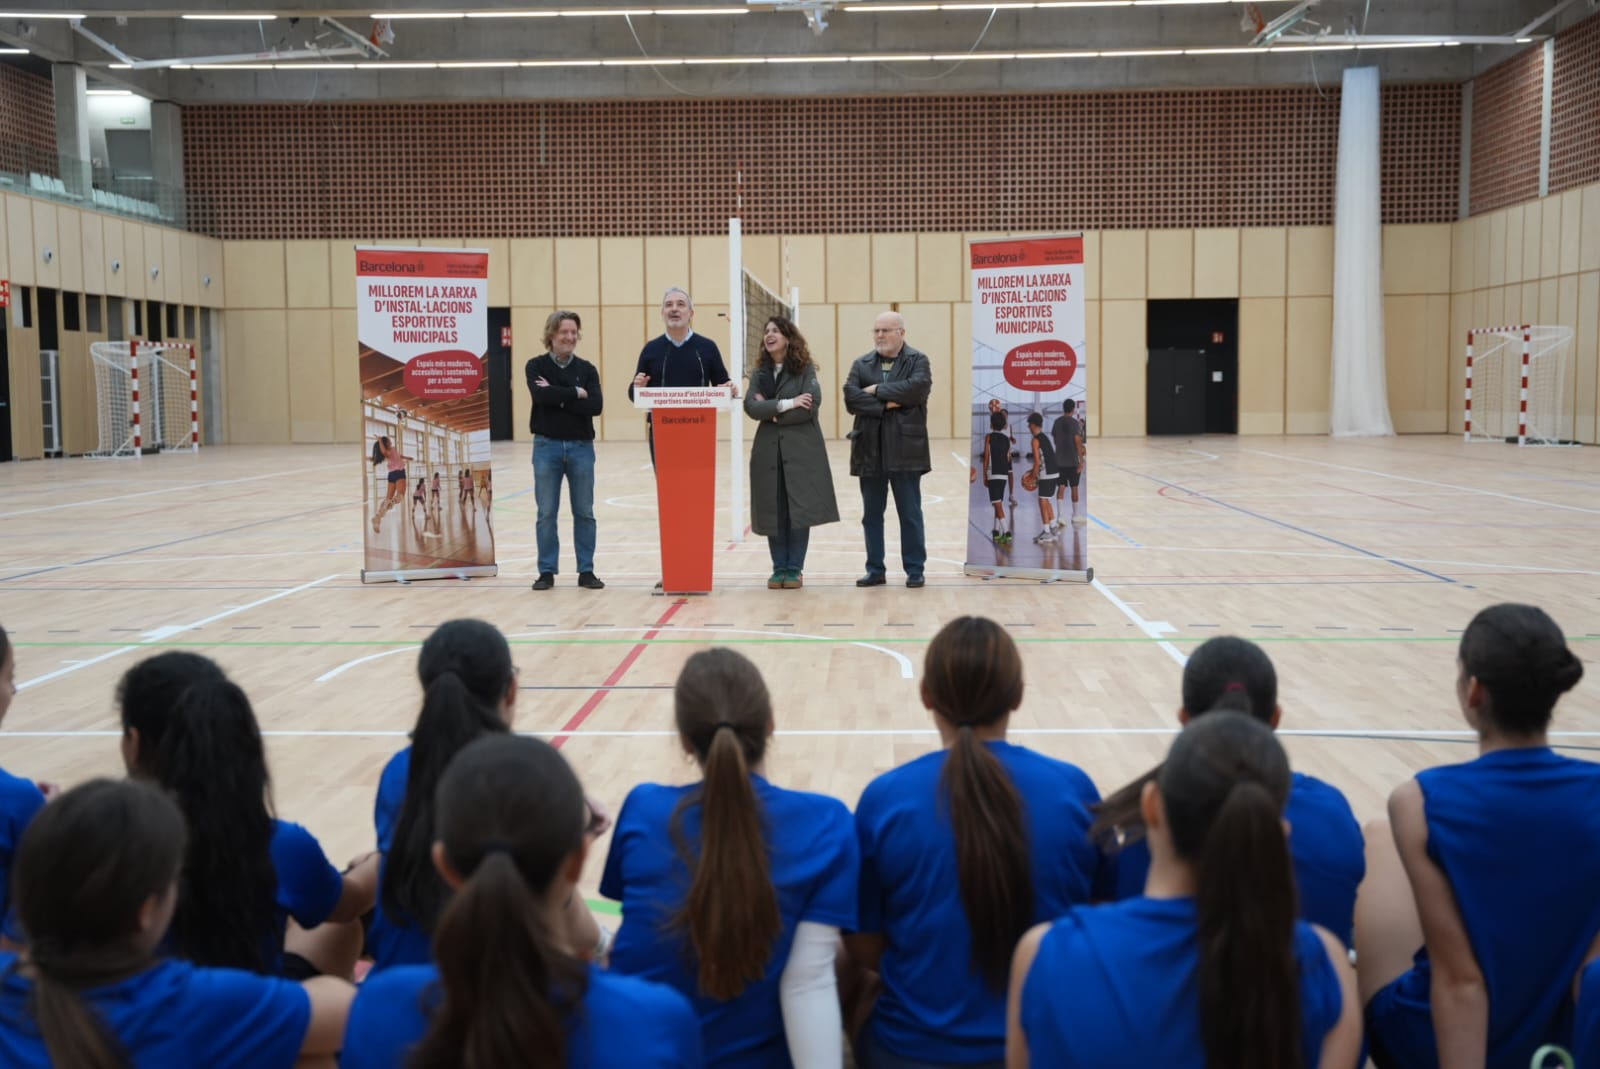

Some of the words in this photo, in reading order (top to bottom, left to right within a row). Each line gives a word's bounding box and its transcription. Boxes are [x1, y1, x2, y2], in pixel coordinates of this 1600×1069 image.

[972, 253, 1017, 265] Barcelona
[360, 260, 415, 273] Barcelona
[977, 275, 1024, 290] MILLOREM
[1026, 274, 1038, 287] LA
[1040, 273, 1072, 287] XARXA
[368, 285, 424, 298] MILLOREM
[425, 286, 439, 298] LA
[441, 286, 478, 299] XARXA
[995, 305, 1053, 319] ESPORTIVES
[391, 315, 457, 329] ESPORTIVES
[995, 320, 1054, 335] MUNICIPALS
[393, 330, 458, 344] MUNICIPALS
[416, 360, 434, 369] Espais
[411, 368, 443, 376] accessibles
[446, 368, 478, 376] sostenibles
[427, 378, 437, 386] per
[661, 415, 699, 424] Barcelona
